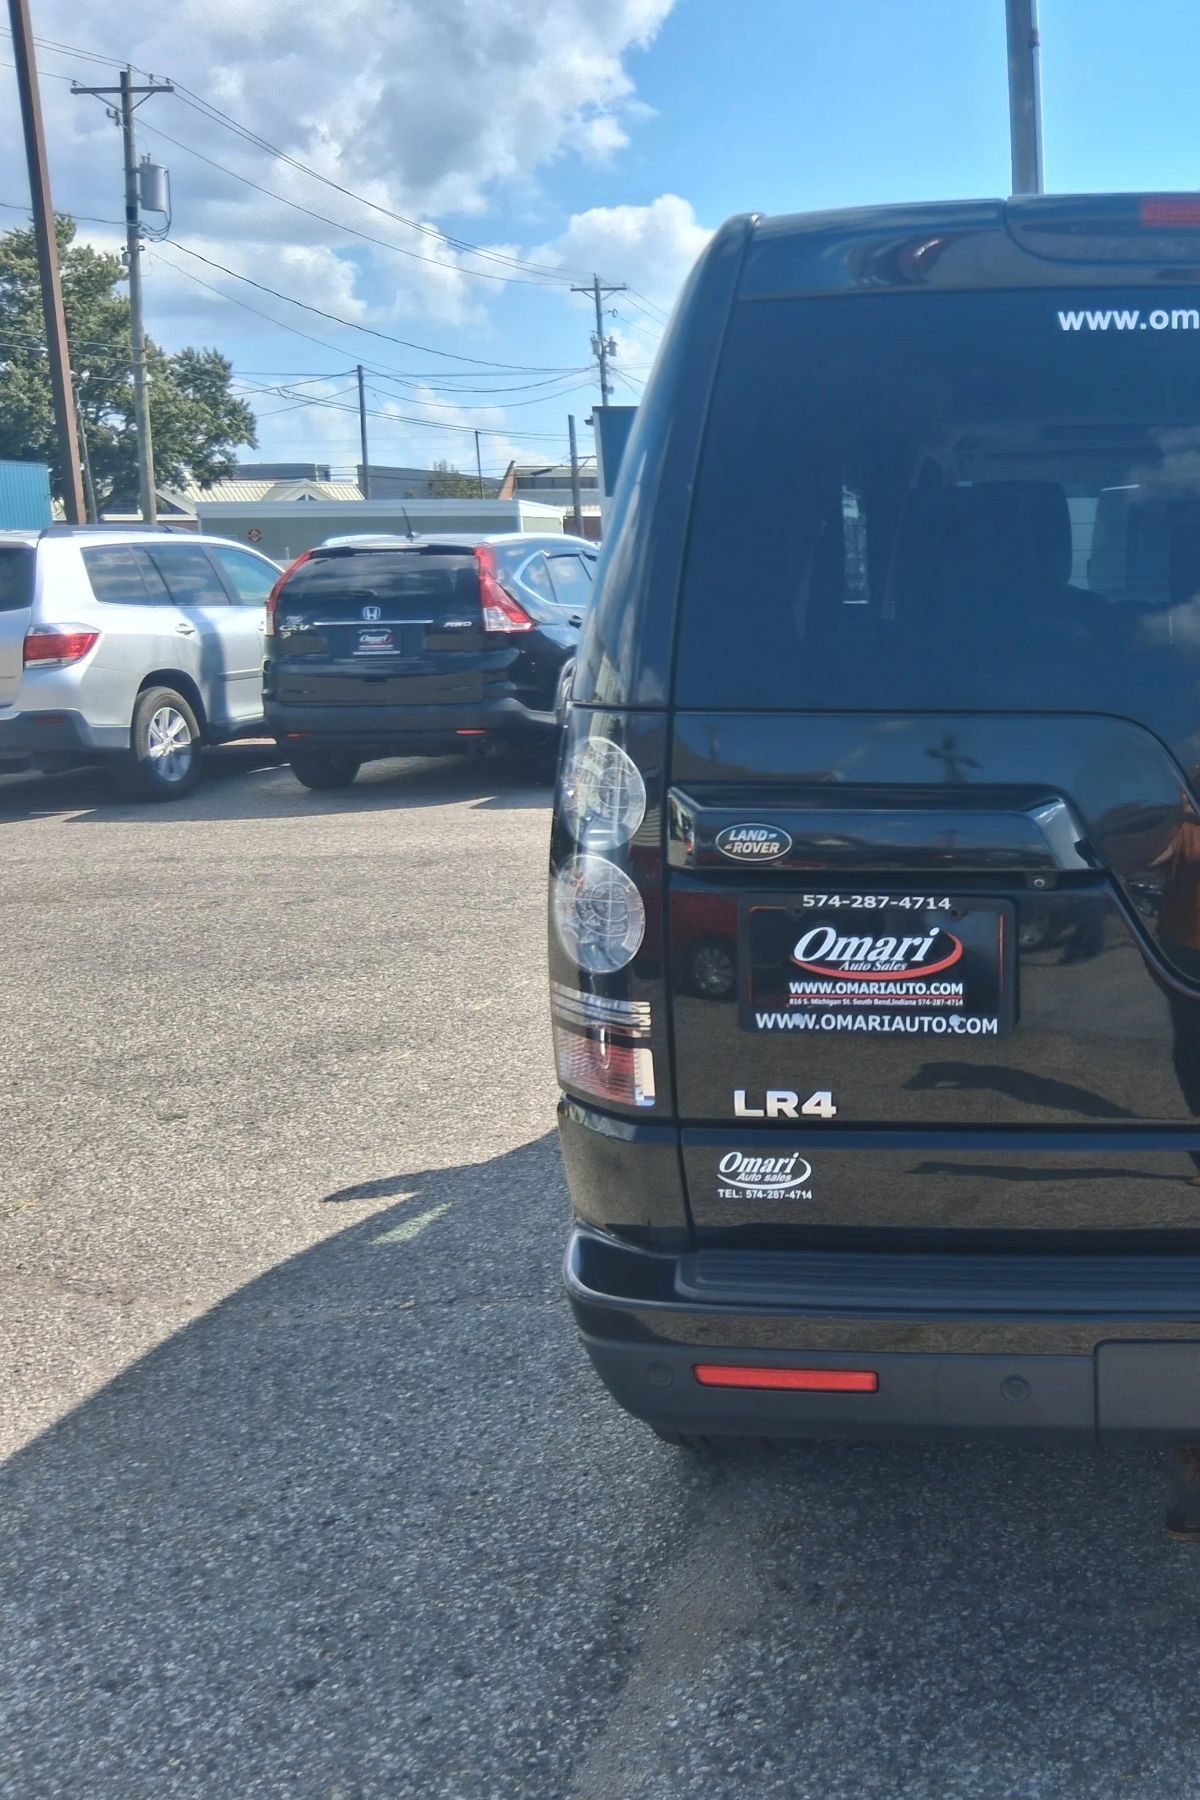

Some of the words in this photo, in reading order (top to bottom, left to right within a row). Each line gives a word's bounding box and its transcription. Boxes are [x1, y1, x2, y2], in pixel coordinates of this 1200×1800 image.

[729, 829, 769, 842] LAND
[733, 842, 780, 854] ROVER
[802, 894, 952, 910] 574-287-4714
[793, 926, 940, 963] Omari
[839, 960, 871, 972] Auto
[873, 960, 907, 972] Sales
[789, 982, 963, 996] WWW.OMARIAUTO.COM
[756, 1012, 998, 1035] WWW.OMARIAUTO.COM
[733, 1089, 837, 1119] LR4
[718, 1151, 800, 1174] Omari
[736, 1173, 762, 1182] Auto
[717, 1188, 743, 1199] TEL:
[746, 1189, 813, 1200] 574-287-4714
